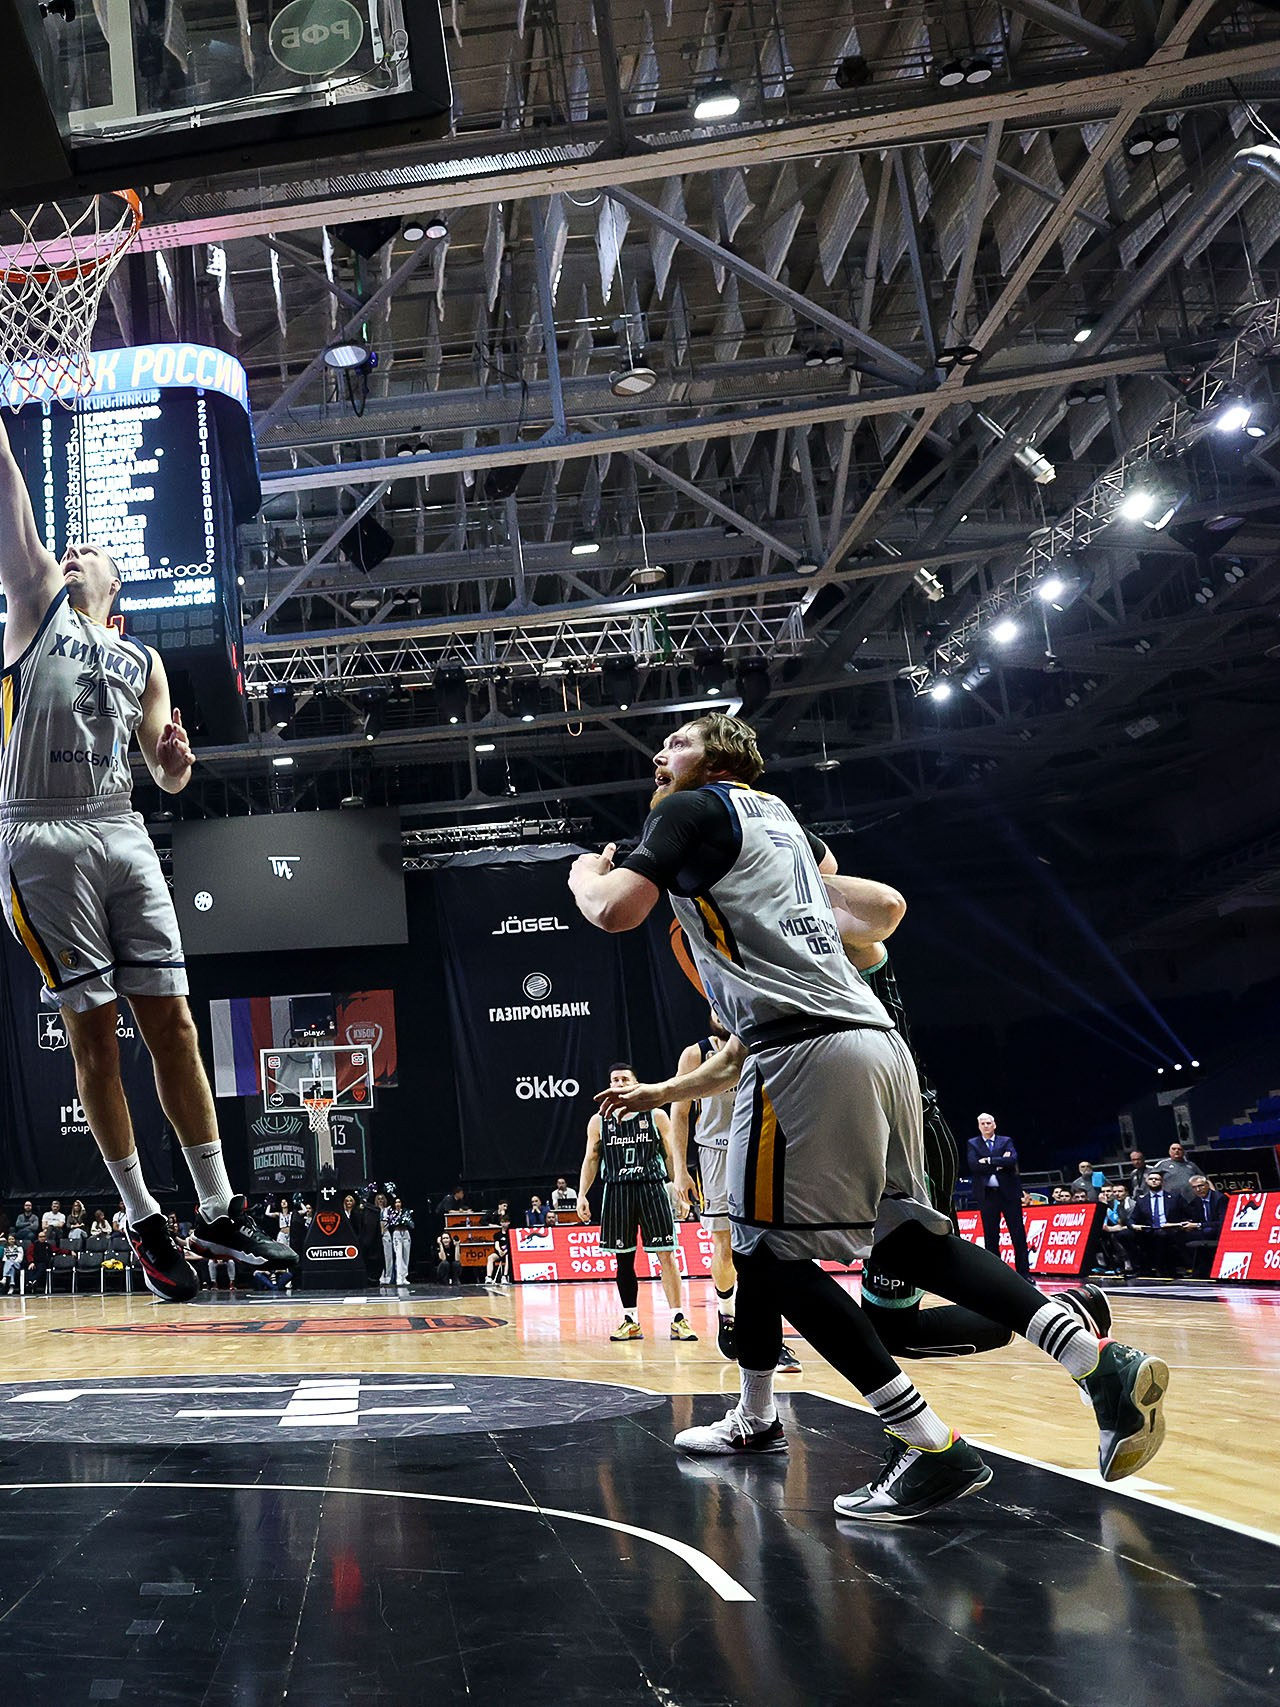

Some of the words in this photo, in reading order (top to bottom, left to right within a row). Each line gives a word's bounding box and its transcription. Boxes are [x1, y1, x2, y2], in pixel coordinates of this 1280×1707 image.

[131, 347, 246, 400] РОССИИ
[64, 495, 81, 509] 20
[492, 916, 569, 935] JÖGEL
[488, 1001, 591, 1022] ГАЗПРОМБАНК
[60, 1125, 90, 1136] group
[331, 1124, 346, 1145] 13
[254, 1152, 305, 1170] ПОБЕДИТЕЛЬ
[625, 1148, 635, 1165] 0
[1048, 1231, 1081, 1245] ENERGY
[310, 1247, 344, 1259] Winline
[1044, 1249, 1061, 1265] 96.8
[1061, 1249, 1076, 1265] FM
[571, 1259, 606, 1273] 96.8
